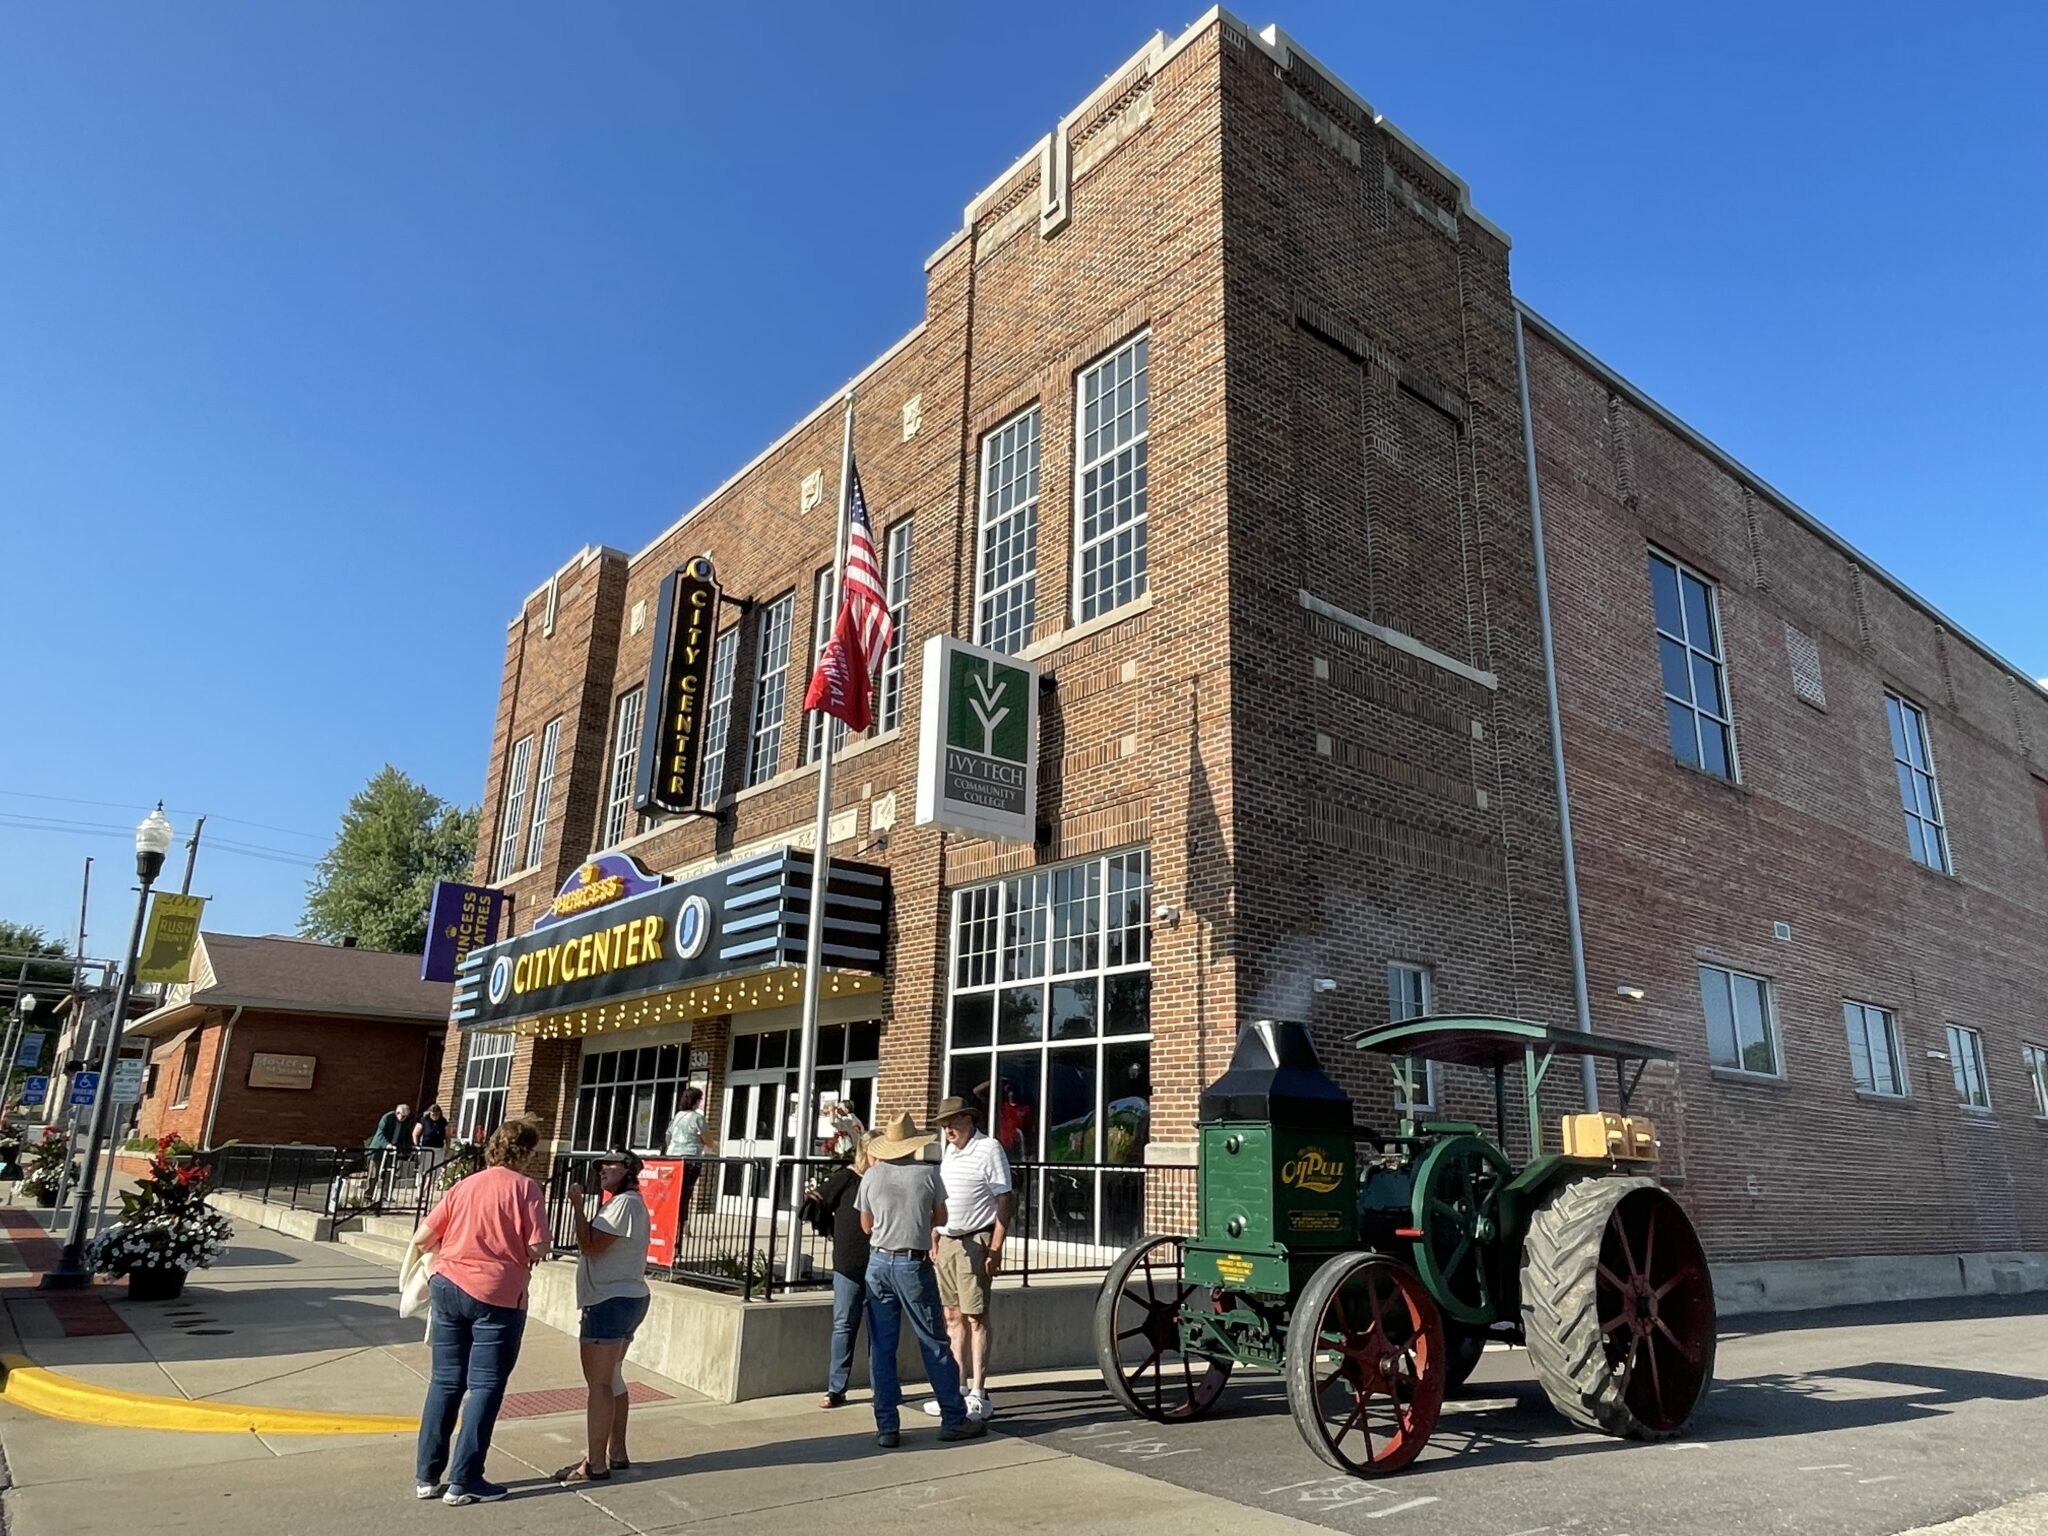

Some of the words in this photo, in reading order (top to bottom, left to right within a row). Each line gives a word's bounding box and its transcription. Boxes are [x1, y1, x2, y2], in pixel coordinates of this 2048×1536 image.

[686, 590, 707, 665] CITY
[671, 675, 698, 795] CENTER
[949, 753, 977, 774] IVY
[981, 761, 1024, 785] TECH
[954, 777, 1016, 800] COMMUNITY
[964, 791, 1007, 809] COLLEGE
[160, 919, 194, 936] RUSH
[513, 944, 561, 994] CITY
[561, 915, 663, 982] CENTER
